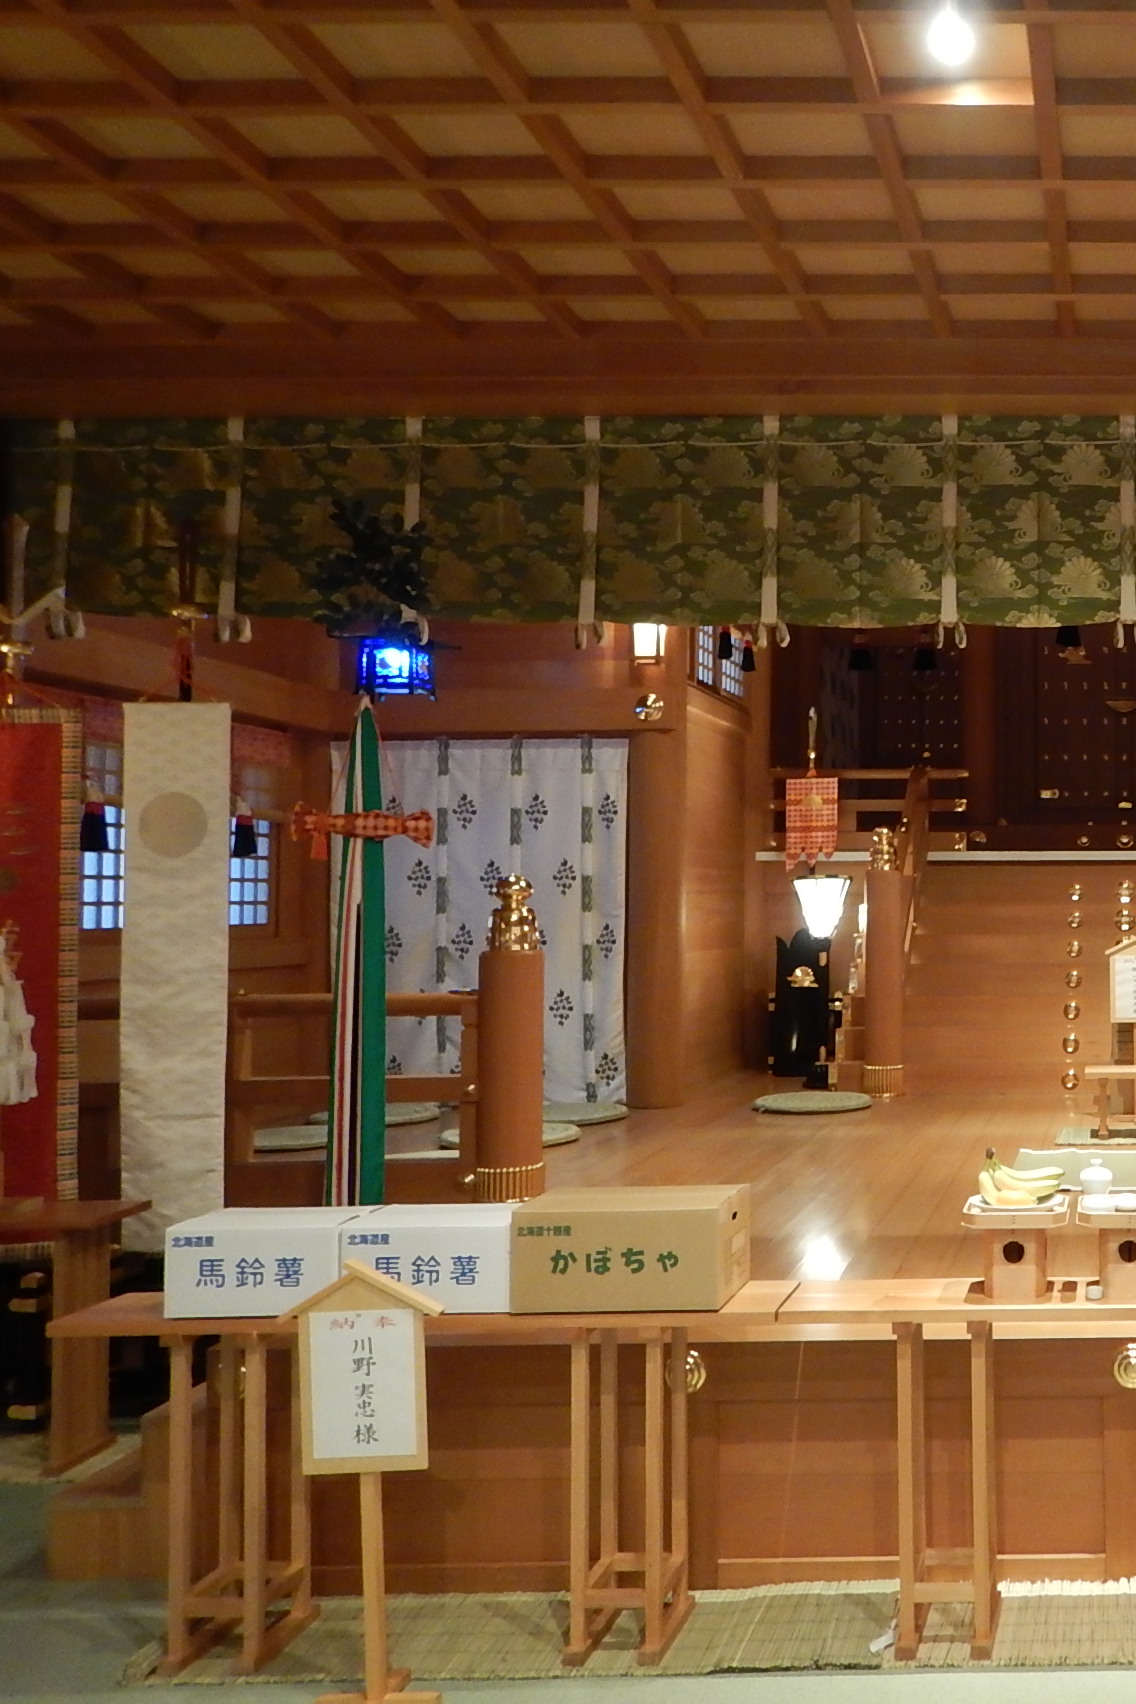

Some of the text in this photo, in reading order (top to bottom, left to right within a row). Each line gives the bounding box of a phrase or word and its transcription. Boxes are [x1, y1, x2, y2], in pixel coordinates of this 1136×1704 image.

[171, 1235, 215, 1248] 北海道産
[347, 1233, 390, 1246] 北海道産
[195, 1257, 305, 1289] 馬鈴薯
[374, 1254, 480, 1287] 馬鈴薯
[549, 1246, 680, 1275] かぼちゃ
